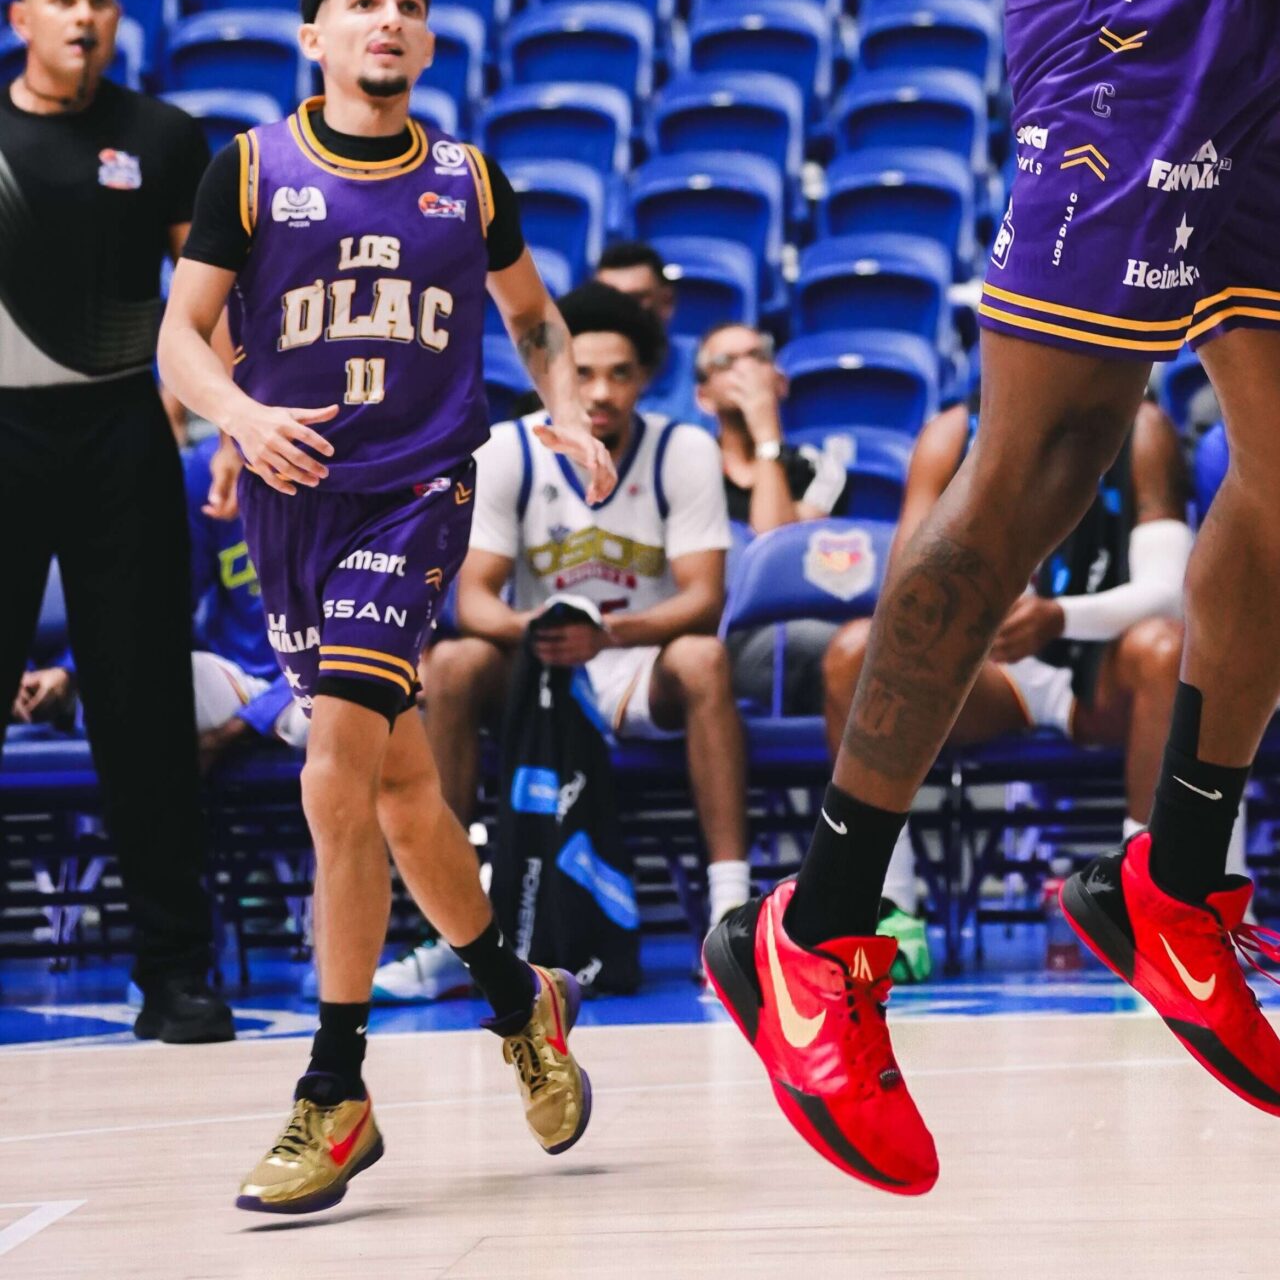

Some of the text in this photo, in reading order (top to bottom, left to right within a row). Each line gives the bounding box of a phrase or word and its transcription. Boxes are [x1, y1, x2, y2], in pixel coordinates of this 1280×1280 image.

[338, 235, 400, 271] LOS
[1052, 239, 1064, 266] LOS
[344, 358, 386, 405] 11
